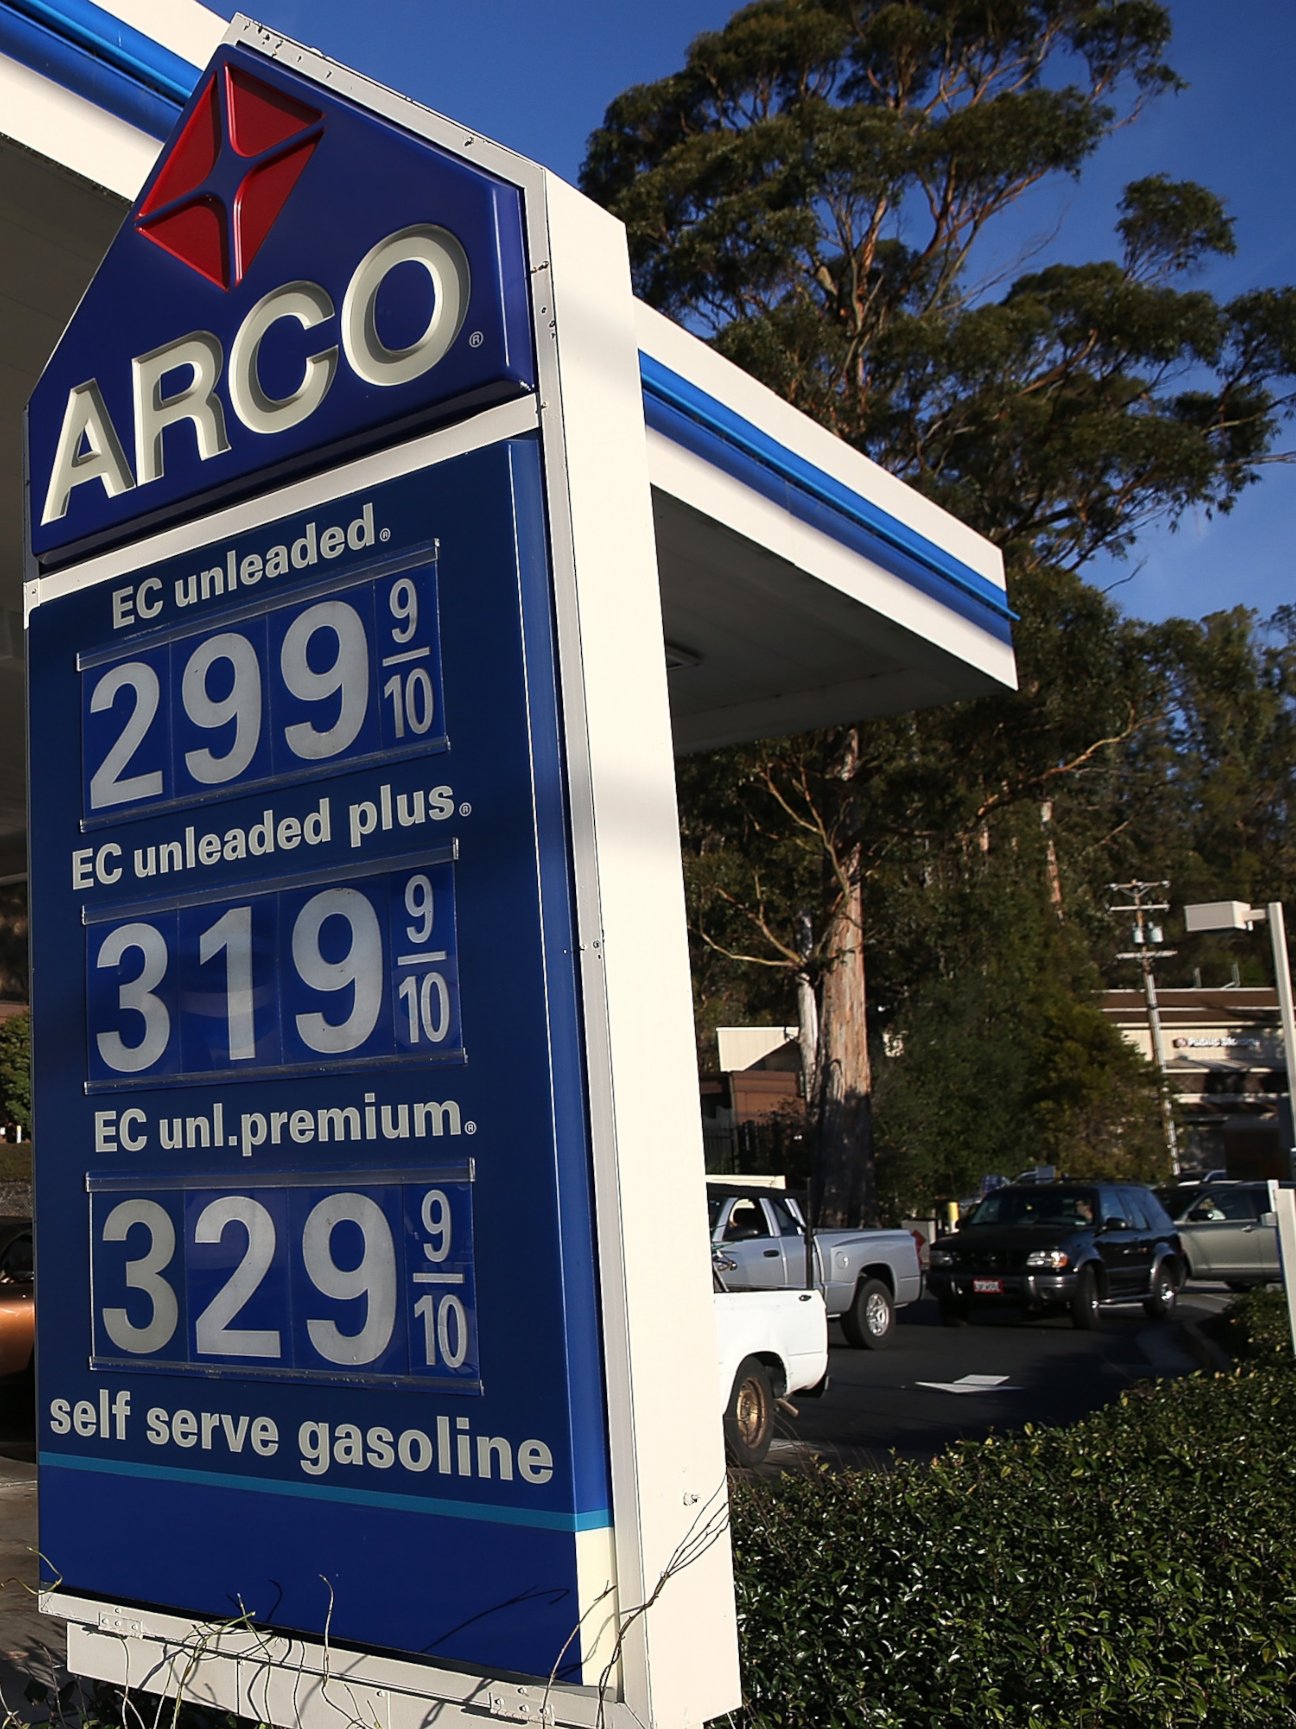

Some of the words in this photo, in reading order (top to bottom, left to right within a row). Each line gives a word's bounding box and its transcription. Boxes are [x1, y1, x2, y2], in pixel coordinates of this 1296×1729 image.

[112, 578, 163, 629] EC
[72, 842, 122, 890] EC
[134, 798, 331, 878] unleaded
[95, 1108, 147, 1152] EC
[50, 1389, 131, 1440] self
[146, 1406, 279, 1457] serve
[298, 1416, 554, 1484] gasoline
